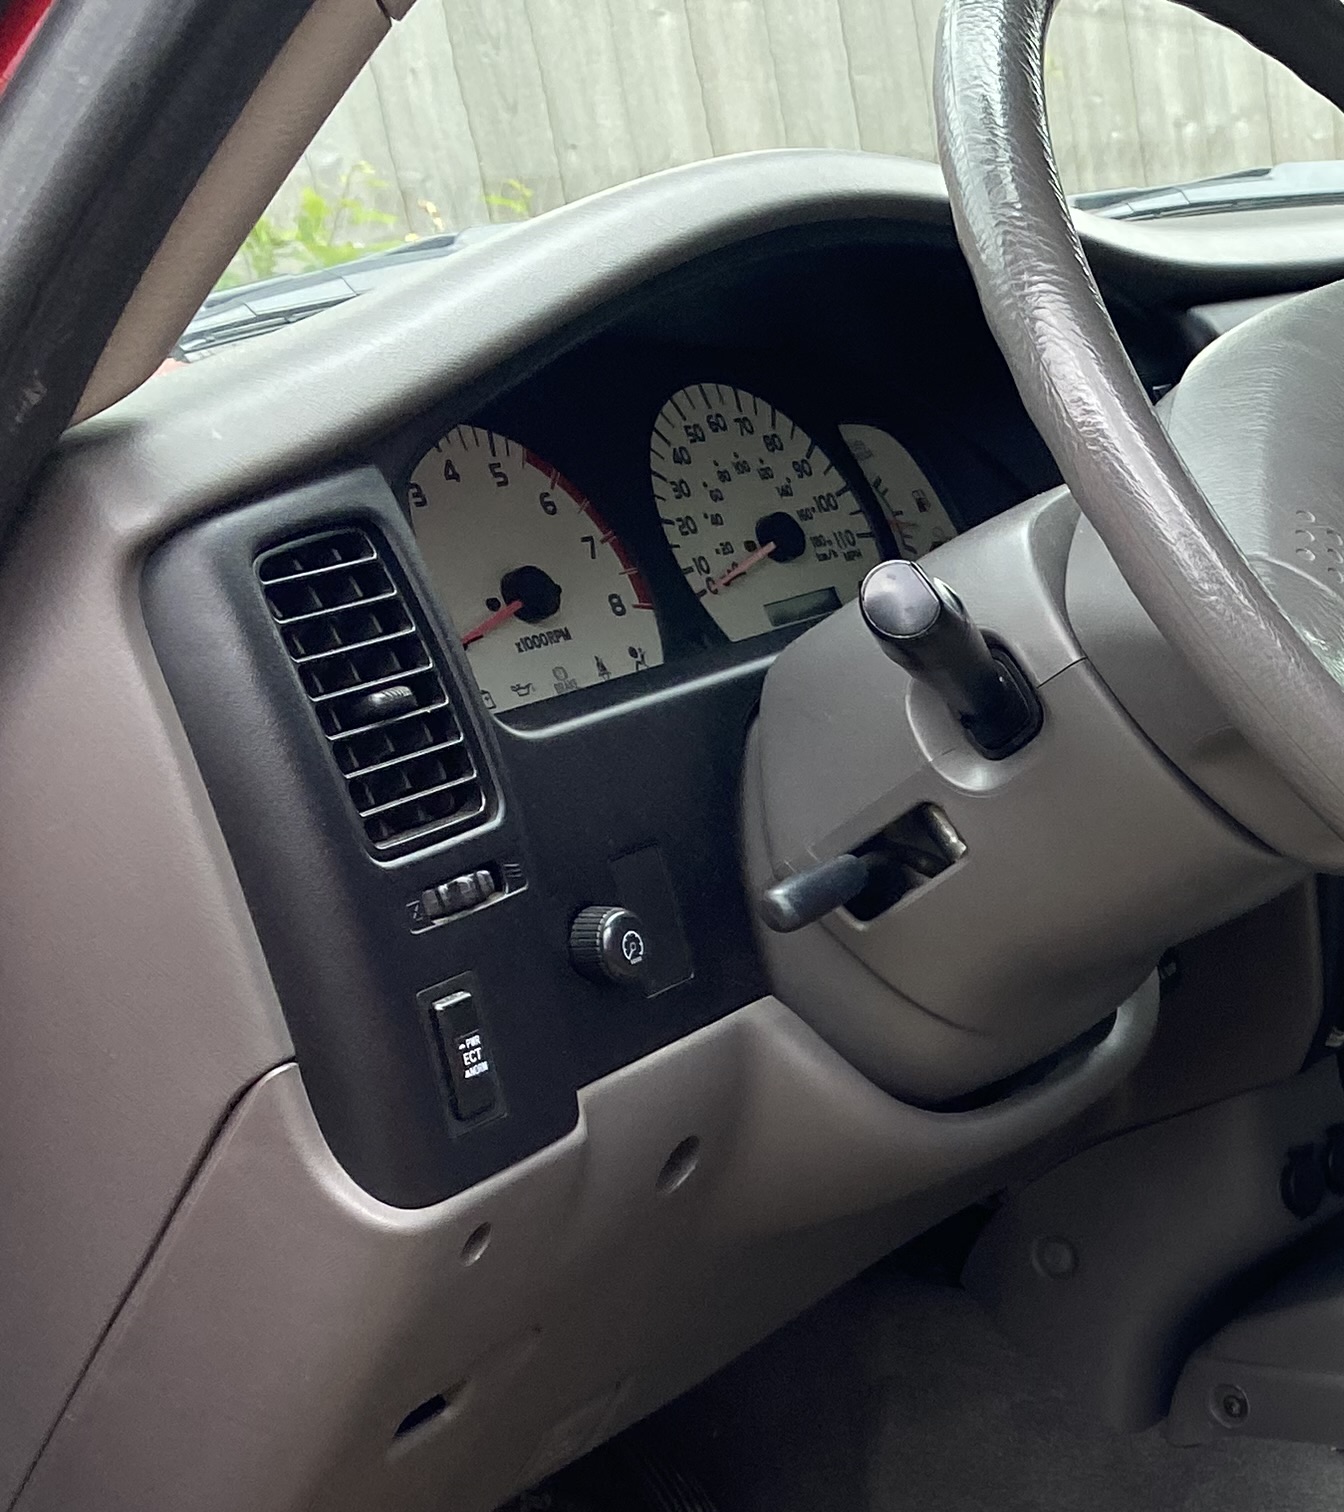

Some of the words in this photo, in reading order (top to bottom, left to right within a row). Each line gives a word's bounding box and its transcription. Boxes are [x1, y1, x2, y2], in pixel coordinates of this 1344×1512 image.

[707, 413, 728, 433] 60
[734, 417, 754, 436] 70
[684, 424, 705, 443] 50
[672, 446, 691, 465] 40
[444, 459, 460, 483] 4
[488, 462, 509, 487] 5
[792, 459, 813, 479] 90
[409, 482, 427, 507] 3
[670, 480, 691, 500] 30
[539, 491, 557, 516] 6
[813, 493, 839, 513] 100
[676, 515, 697, 536] 20
[581, 534, 599, 561] 7
[834, 529, 856, 548] 110
[693, 556, 710, 575] 10
[607, 593, 626, 617] 8
[465, 1035, 481, 1049] PWR
[462, 1047, 482, 1066] ECT
